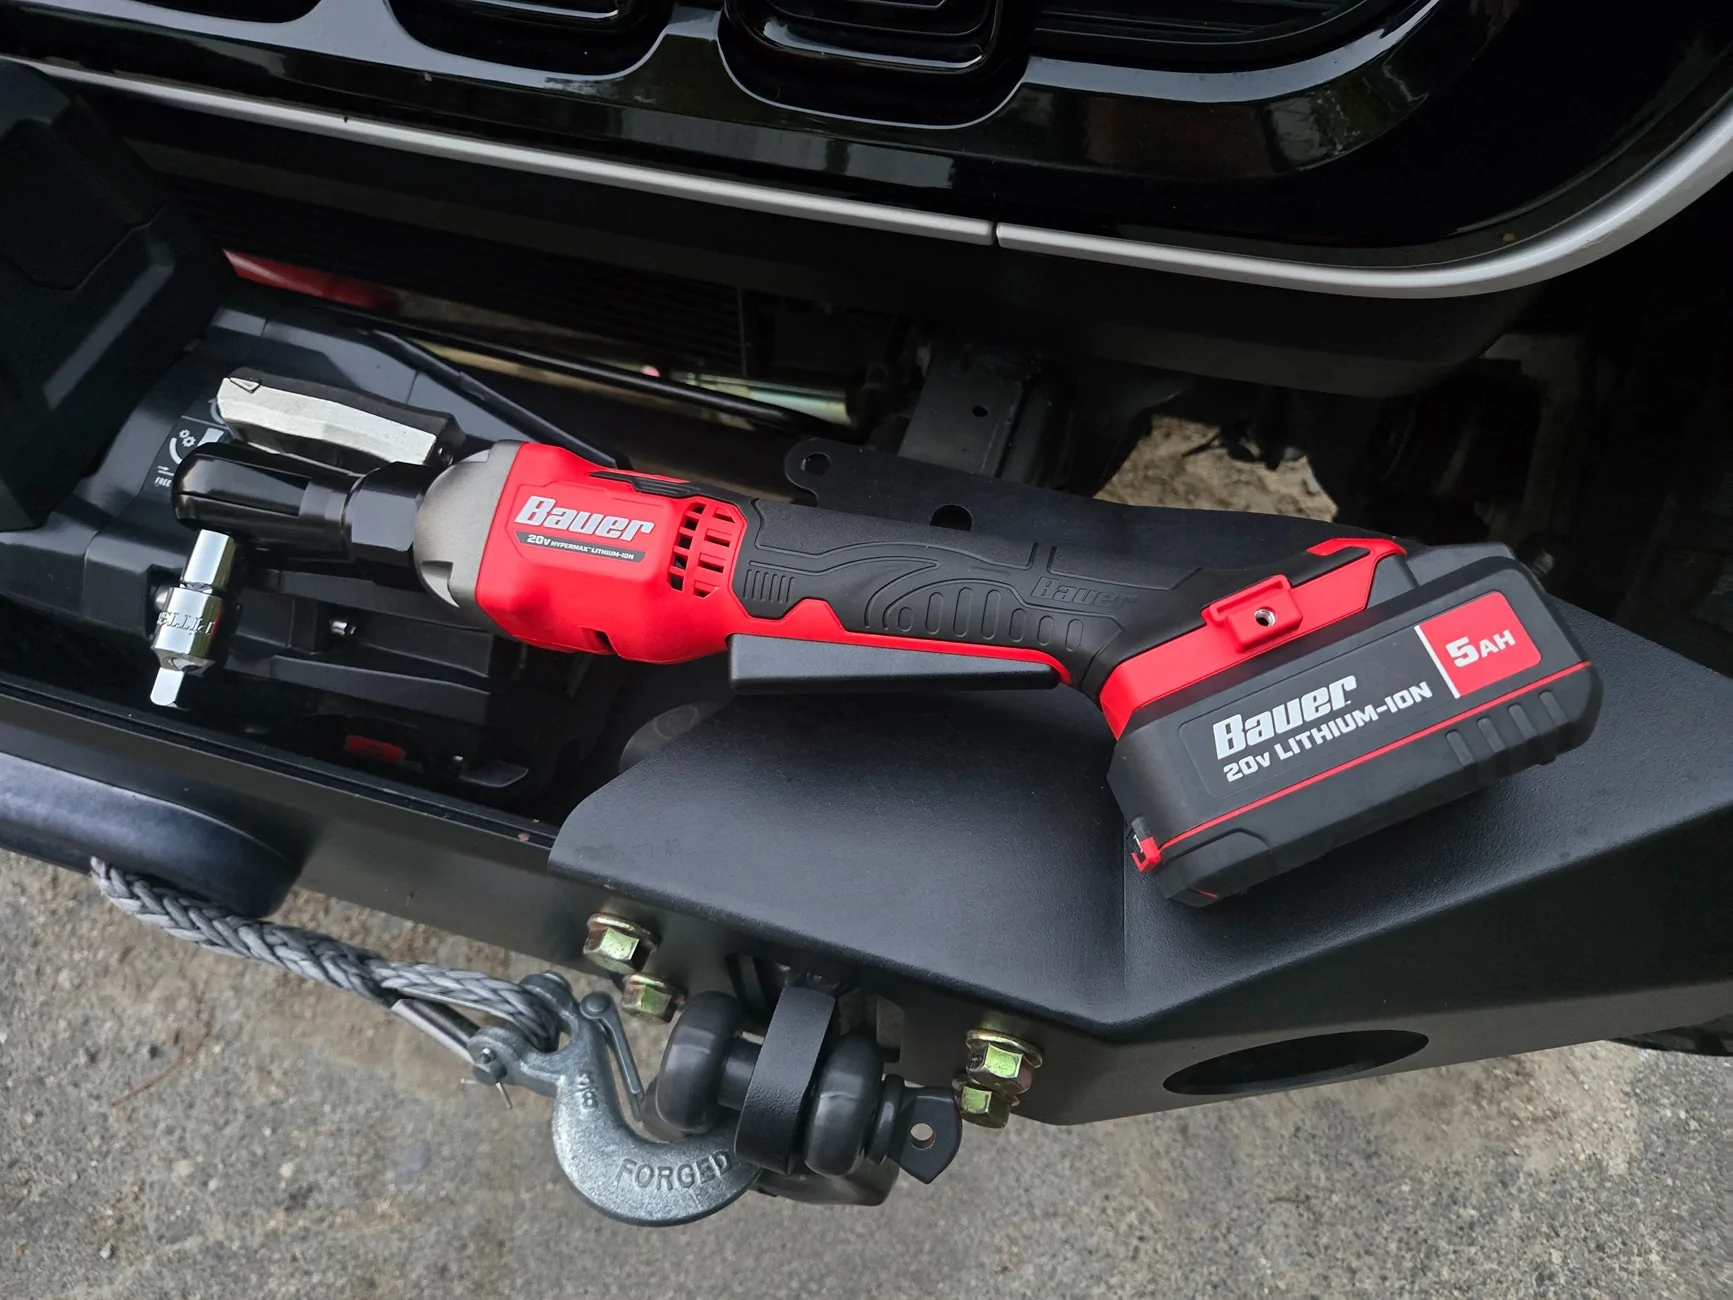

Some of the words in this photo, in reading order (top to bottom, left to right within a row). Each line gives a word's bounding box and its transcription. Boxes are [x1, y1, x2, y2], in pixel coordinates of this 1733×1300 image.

[514, 495, 655, 541] Bauer
[591, 547, 634, 560] LITHIUM-ION
[1030, 576, 1138, 608] Bauer
[1445, 629, 1516, 667] 5AH
[1212, 675, 1357, 759] Bauer
[1277, 681, 1433, 760] LITHIUM-ION
[614, 1150, 732, 1191] FORGED
